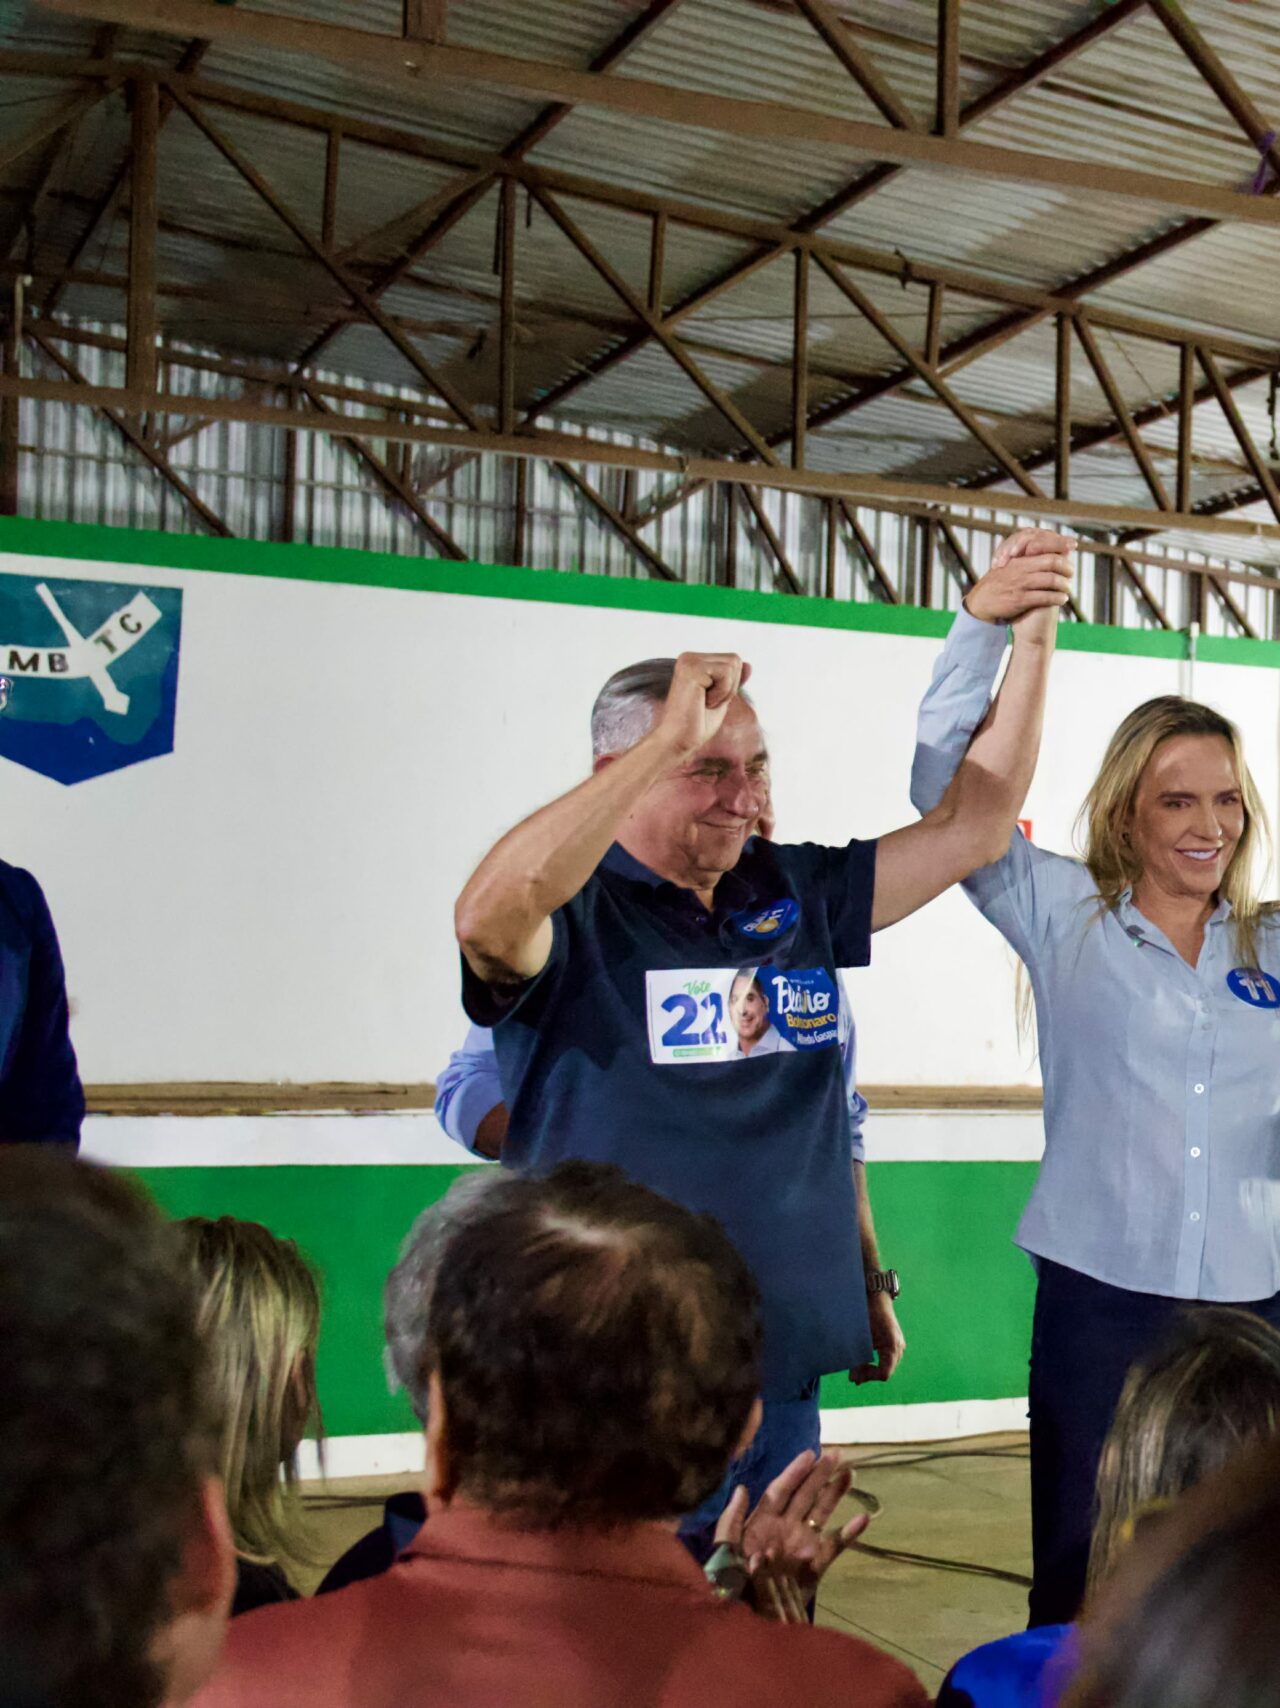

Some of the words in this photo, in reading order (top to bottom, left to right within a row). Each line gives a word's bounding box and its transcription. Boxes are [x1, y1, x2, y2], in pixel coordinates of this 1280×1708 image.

[683, 980, 711, 996] Vote
[1239, 978, 1276, 1002] 11
[661, 992, 727, 1046] 22
